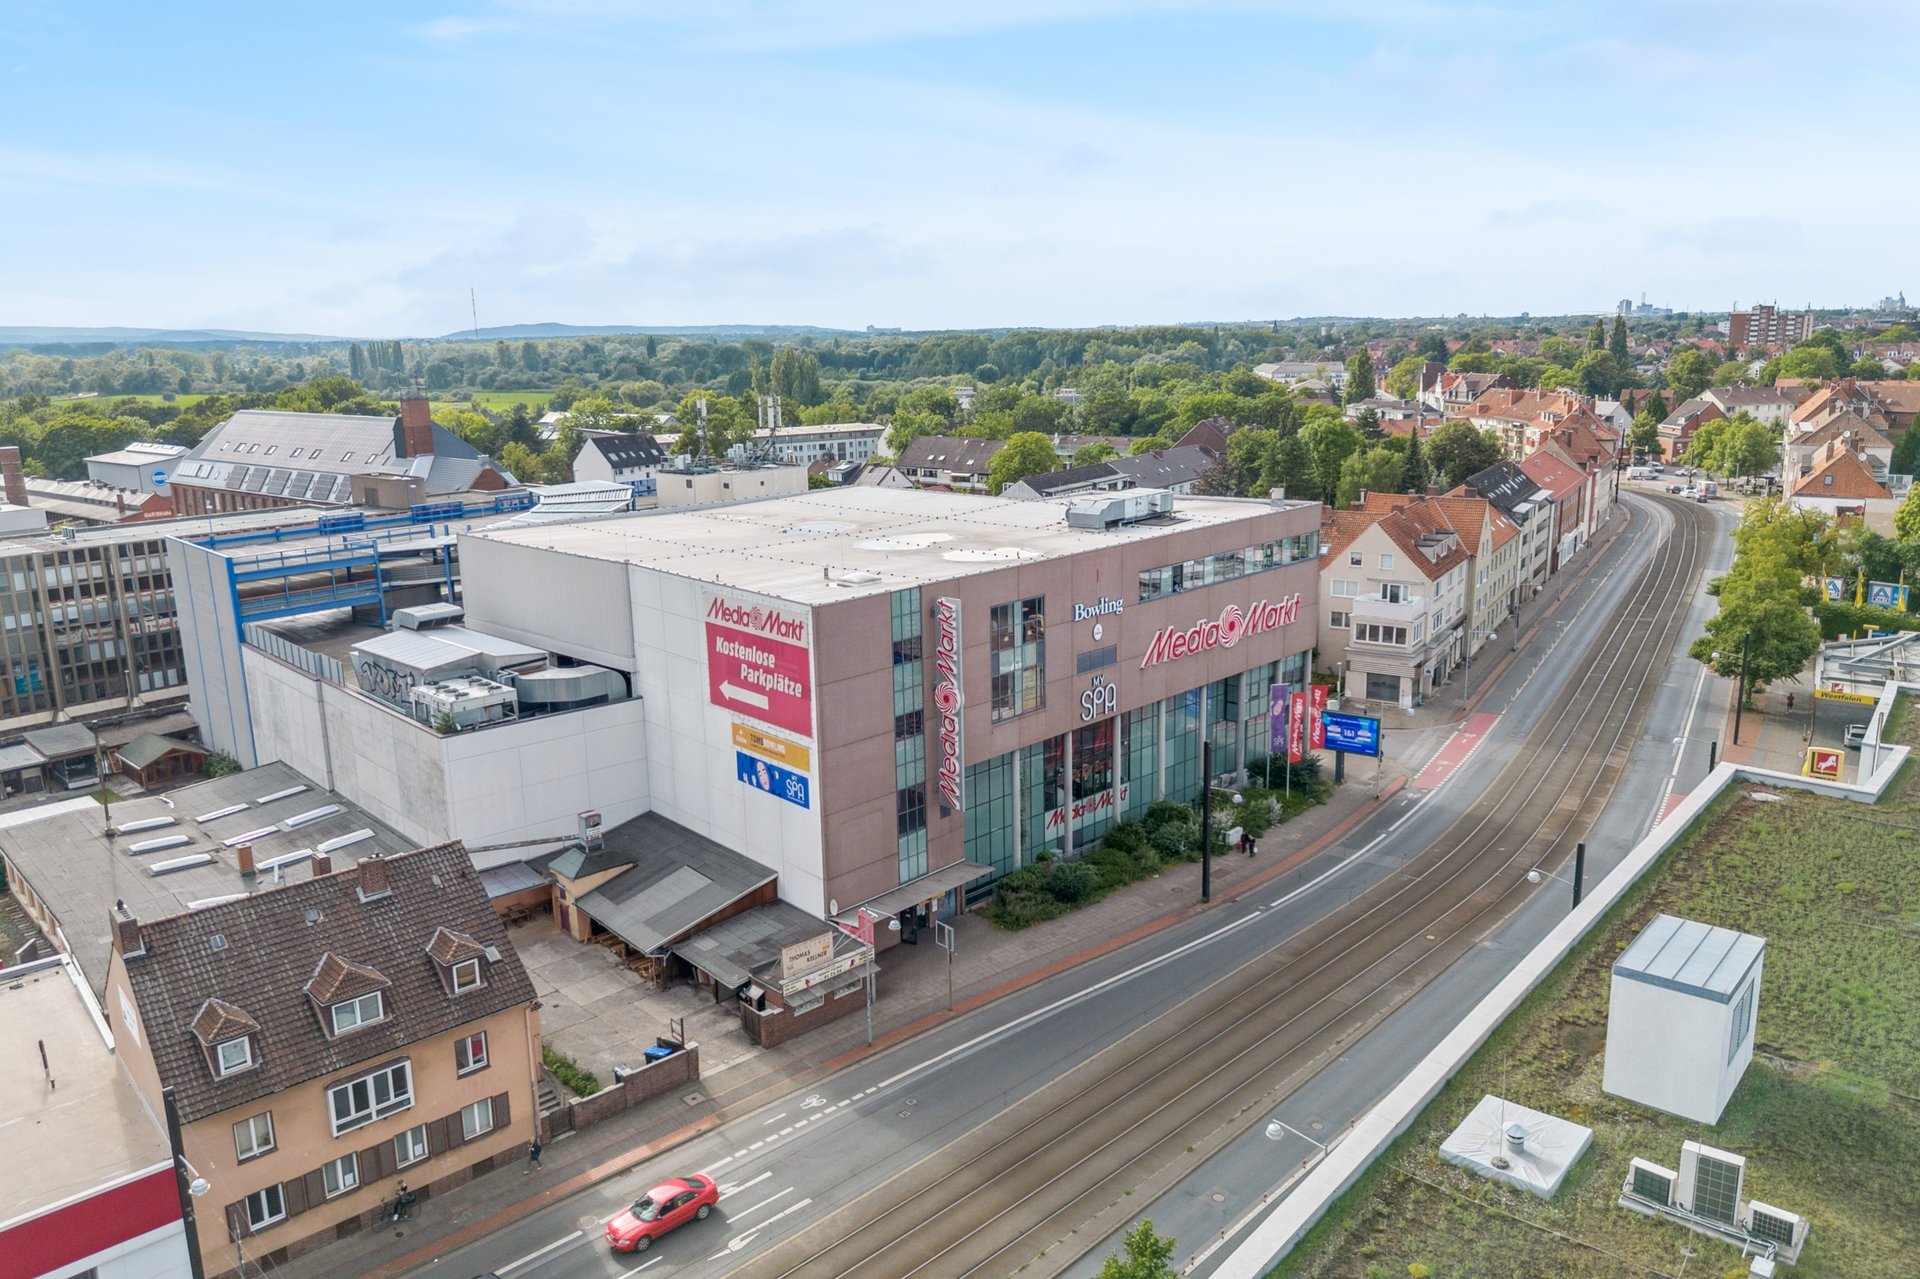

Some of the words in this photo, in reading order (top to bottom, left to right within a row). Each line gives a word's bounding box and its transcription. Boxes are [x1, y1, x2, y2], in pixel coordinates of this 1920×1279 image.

[707, 597, 750, 628] Media
[761, 610, 804, 641] Markt
[1073, 597, 1123, 621] Bowling
[936, 598, 957, 687] Markt
[1140, 619, 1220, 669] Media
[1240, 592, 1300, 640] Markt
[716, 636, 775, 668] Kostenlose
[741, 663, 802, 697] Parkplätze
[1092, 675, 1104, 687] MY
[1081, 683, 1116, 721] SPA
[1821, 691, 1862, 702] Westfalen
[938, 713, 960, 811] Media
[786, 779, 804, 801] SPA
[1095, 786, 1128, 811] Makt
[788, 949, 811, 962] THOMAS
[807, 950, 828, 963] KELLNER
